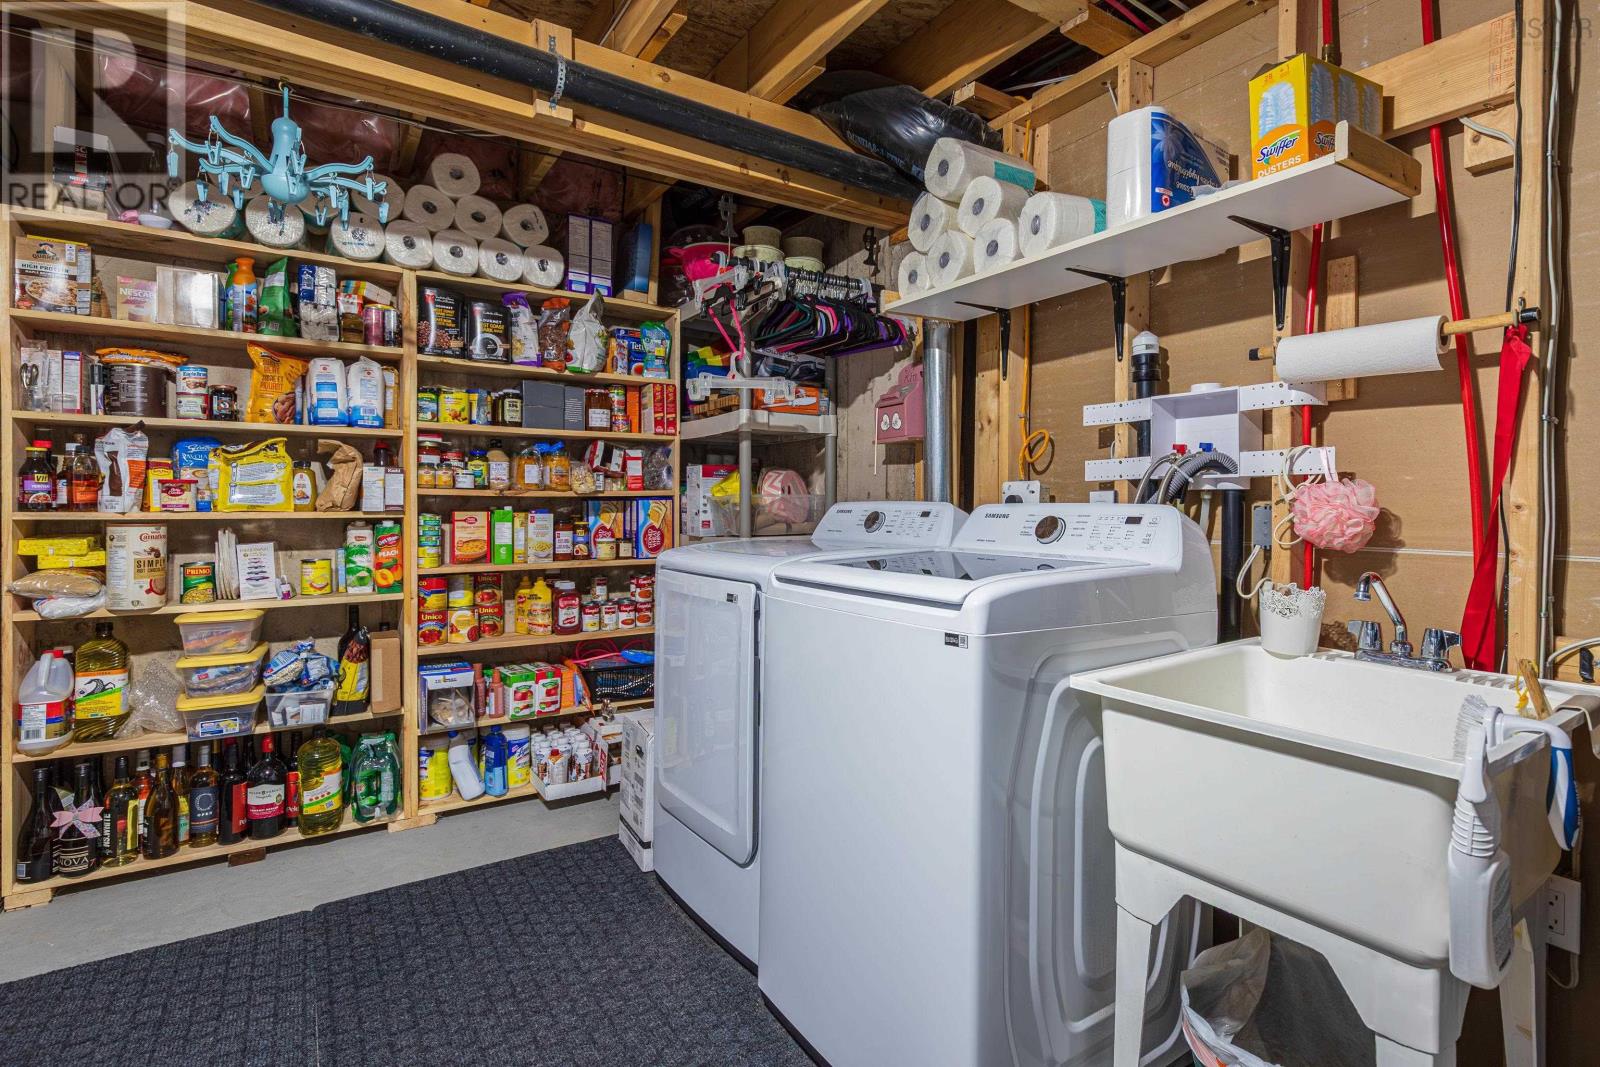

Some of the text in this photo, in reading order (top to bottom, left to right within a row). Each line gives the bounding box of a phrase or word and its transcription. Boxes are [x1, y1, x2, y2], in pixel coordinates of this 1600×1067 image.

[1257, 136, 1299, 162] Swiffer
[1257, 154, 1302, 179] DUSTERS
[186, 567, 210, 576] PRIMO
